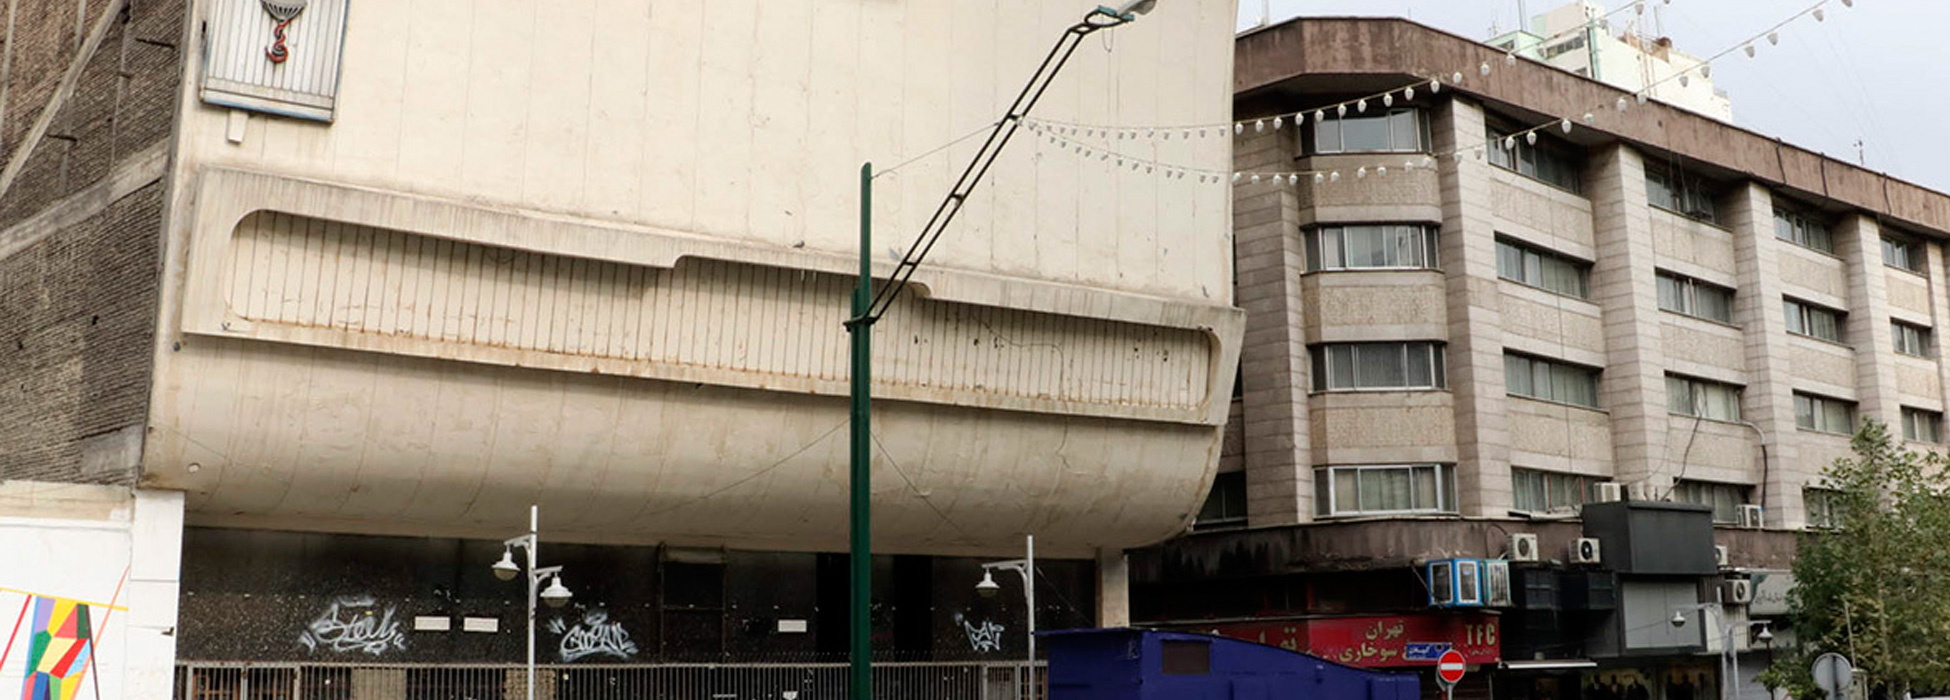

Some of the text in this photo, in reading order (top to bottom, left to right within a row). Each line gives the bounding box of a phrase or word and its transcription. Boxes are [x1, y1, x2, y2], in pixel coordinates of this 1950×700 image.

[1364, 619, 1404, 640] تهران
[1466, 623, 1496, 645] TFC
[1339, 640, 1398, 662] سوخاری
